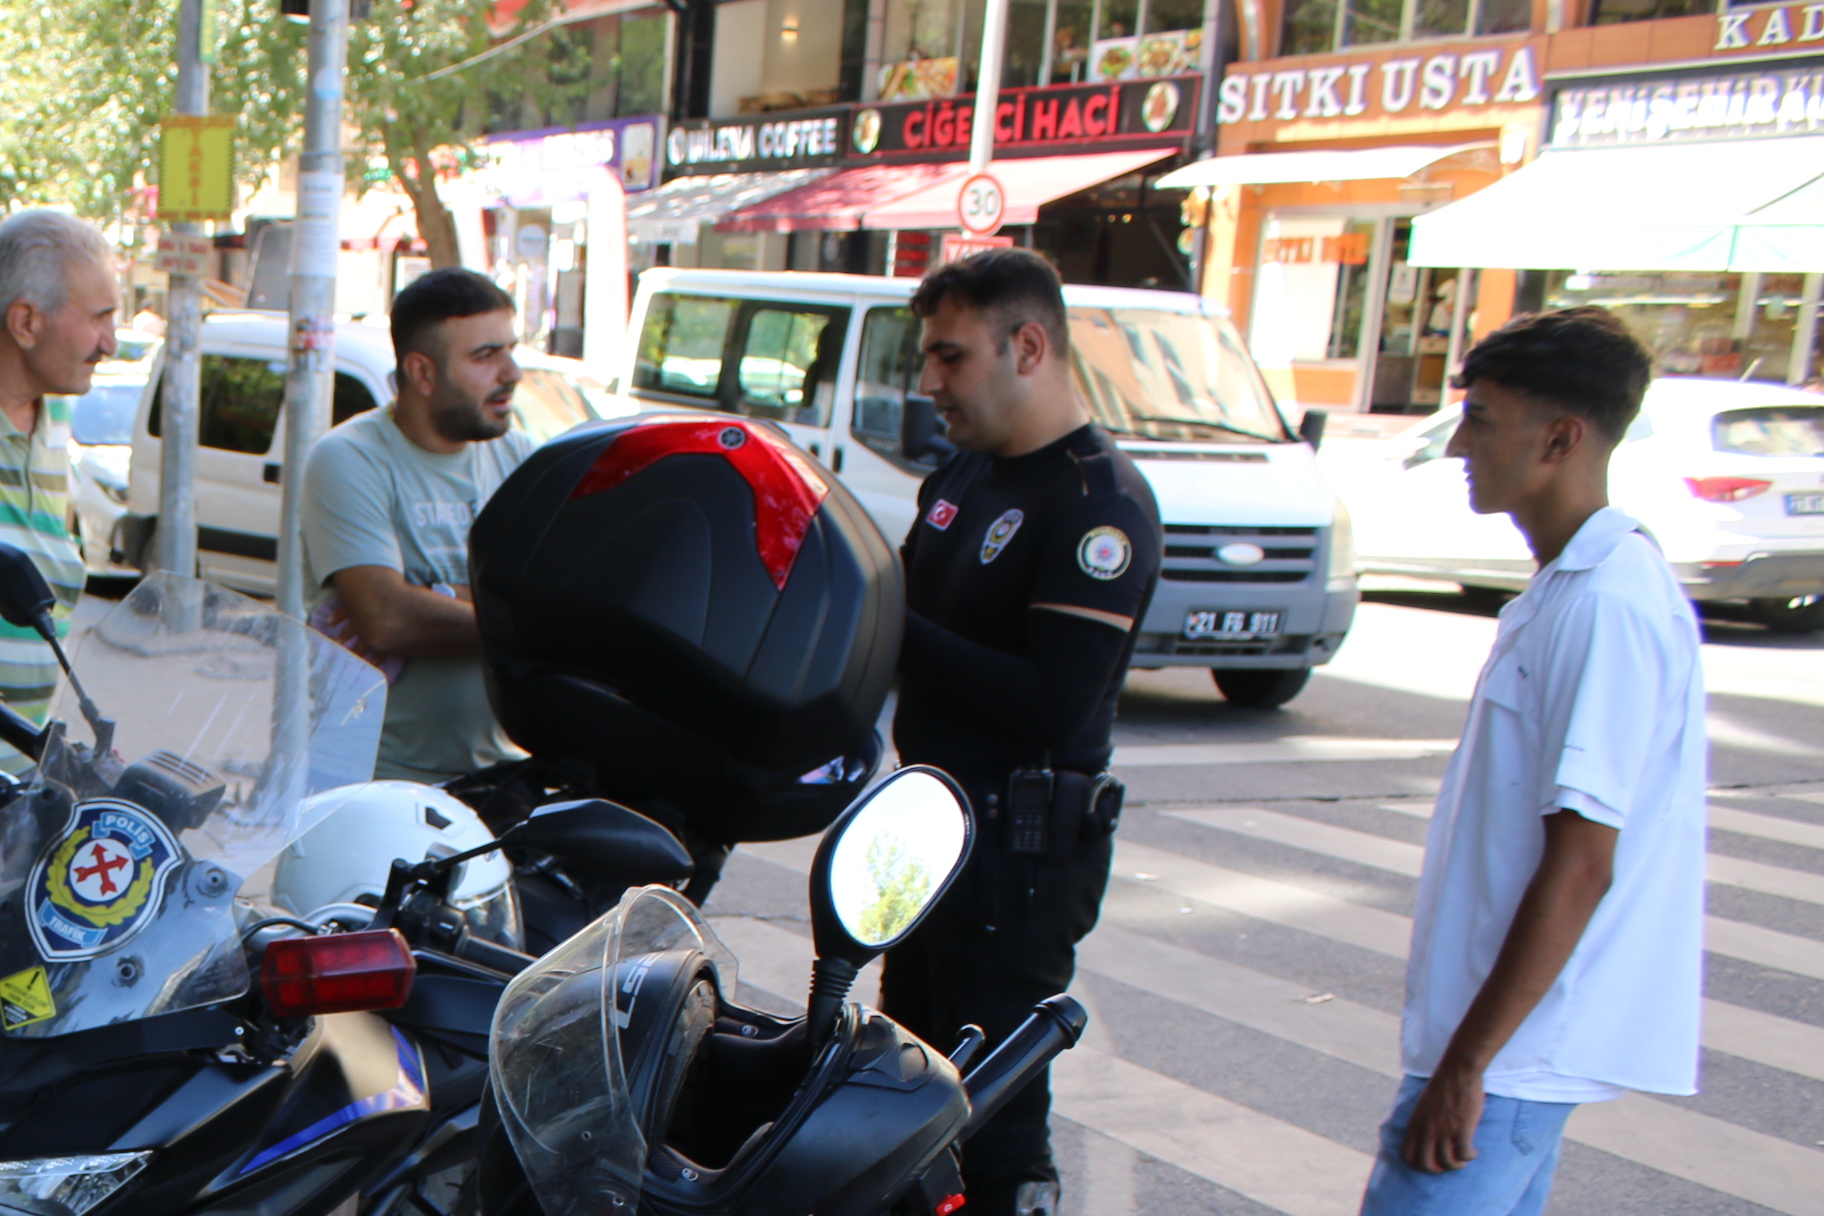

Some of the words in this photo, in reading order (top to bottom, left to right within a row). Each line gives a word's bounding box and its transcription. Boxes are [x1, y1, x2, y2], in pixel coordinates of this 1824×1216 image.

[1217, 64, 1370, 124] SITKI
[1380, 46, 1539, 112] USTA
[758, 117, 838, 160] COFFEE
[903, 92, 1025, 149] CİĞECİ
[967, 188, 998, 216] 30
[104, 813, 149, 844] POLİS
